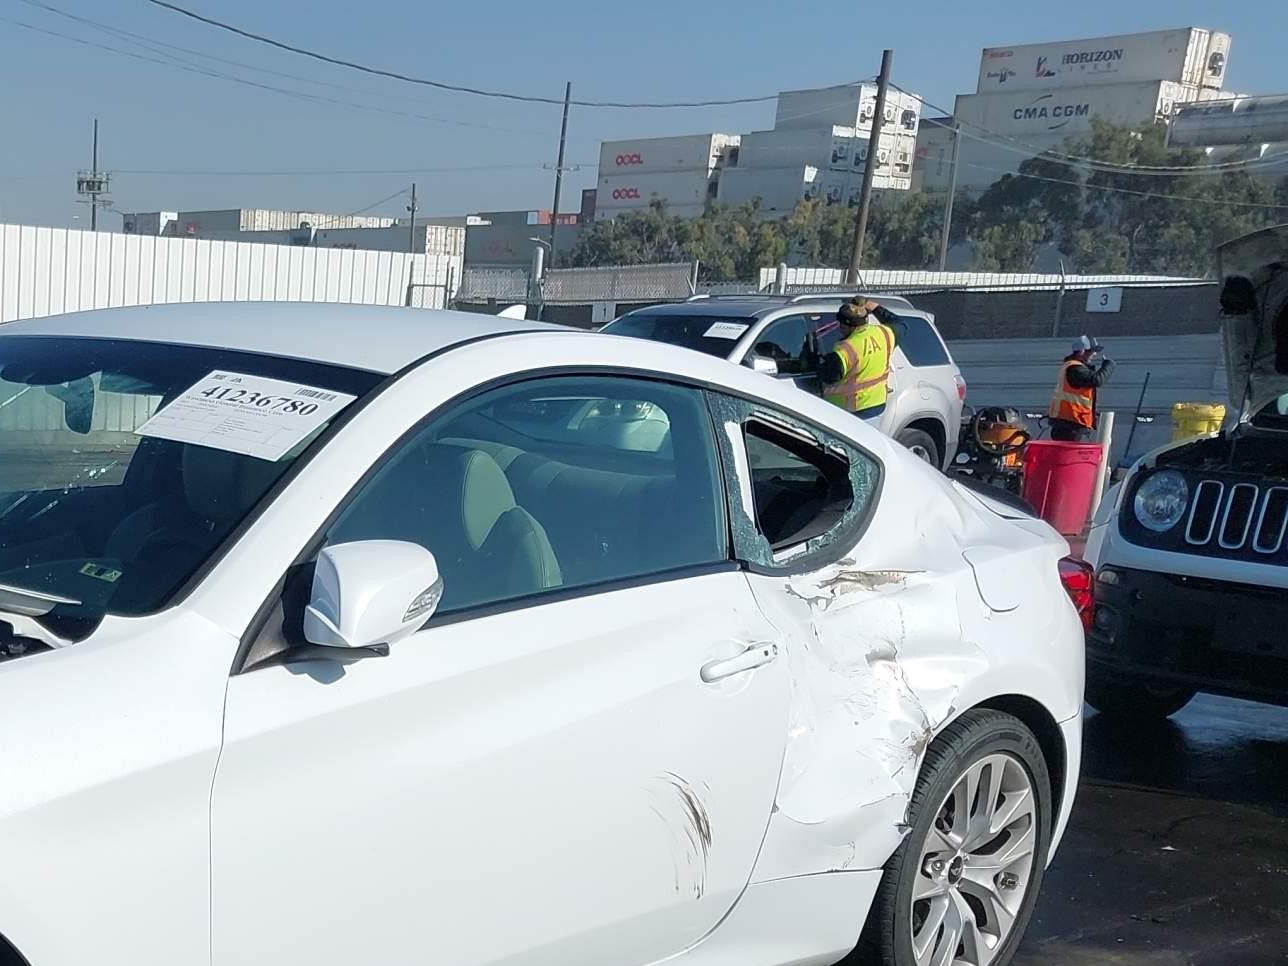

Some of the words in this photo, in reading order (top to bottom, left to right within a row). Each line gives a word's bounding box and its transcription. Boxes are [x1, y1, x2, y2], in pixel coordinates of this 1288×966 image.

[1061, 49, 1124, 65] HORIZON
[1013, 106, 1048, 120] CMA
[1053, 103, 1090, 118] CGM
[615, 153, 644, 166] OOCL
[612, 188, 641, 200] OOCL
[1099, 293, 1109, 306] 3
[200, 385, 319, 417] 41236780
